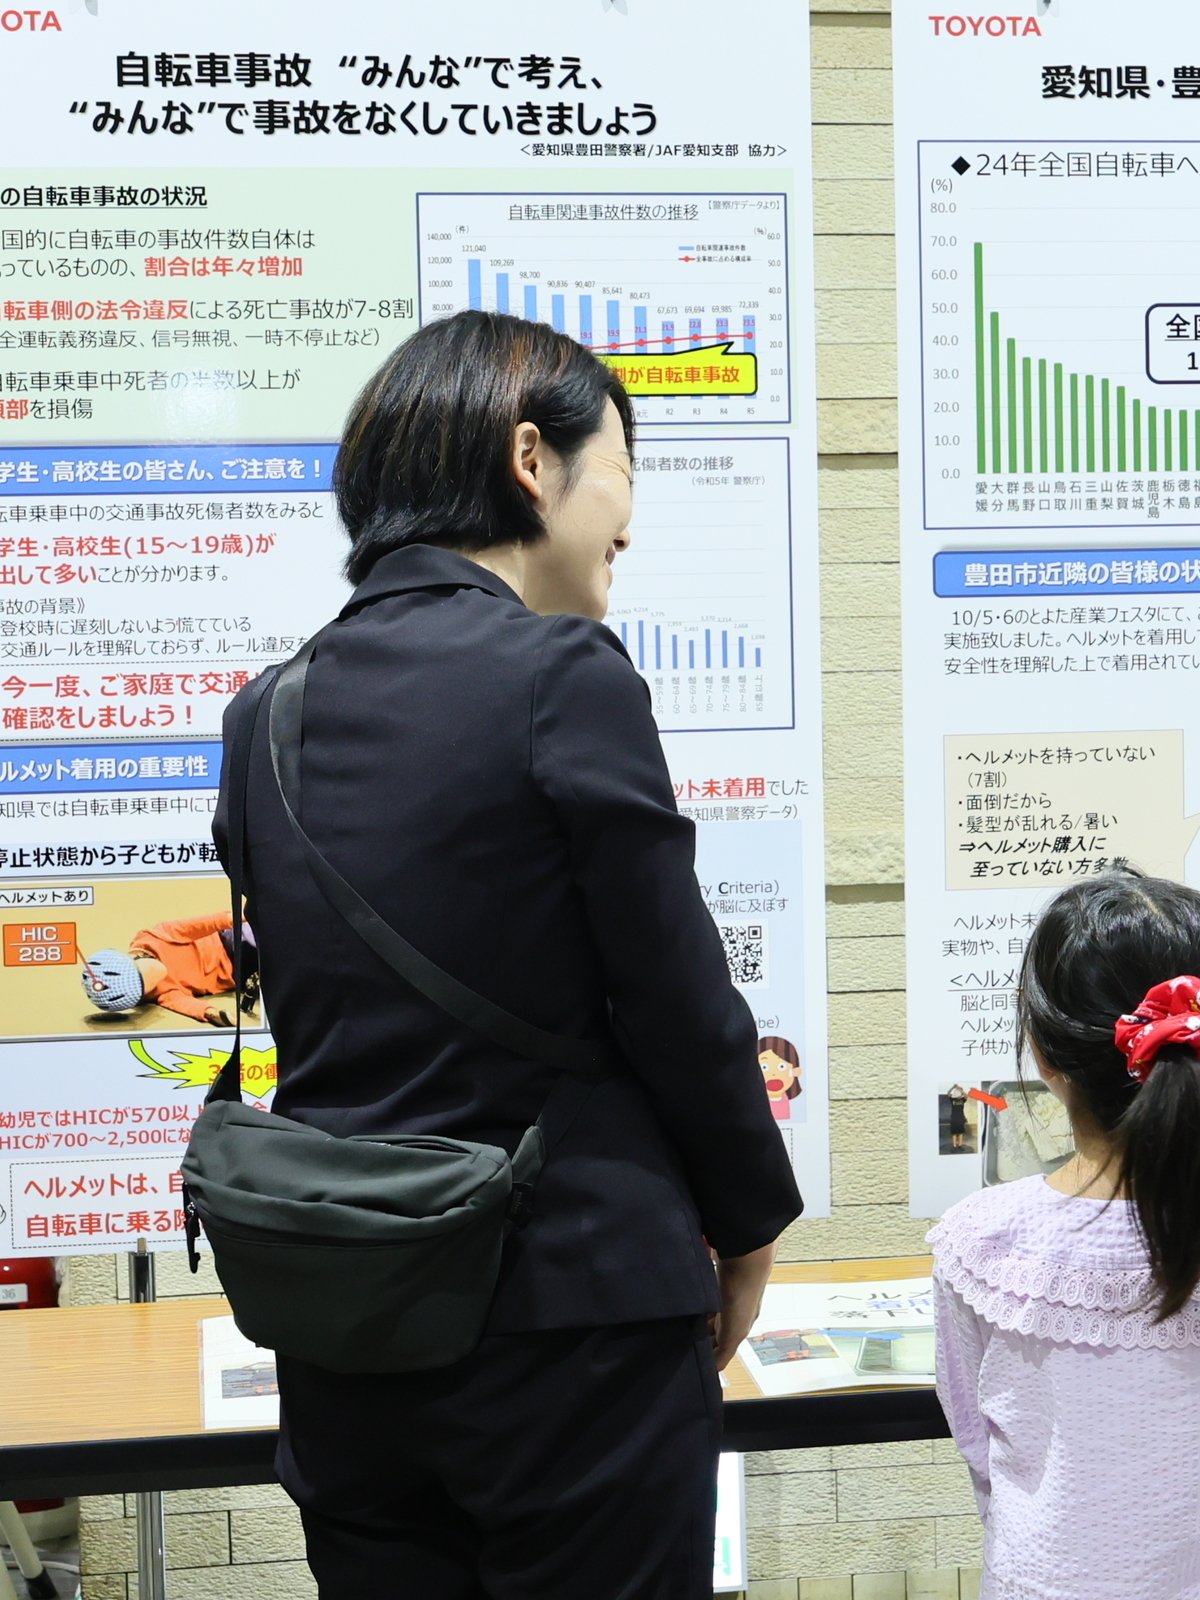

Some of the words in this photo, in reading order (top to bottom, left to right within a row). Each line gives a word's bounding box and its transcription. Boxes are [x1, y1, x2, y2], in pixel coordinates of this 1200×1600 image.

[1, 10, 62, 31] OTA
[928, 16, 1042, 36] TOYOTA
[115, 52, 312, 88] 自転車事故
[930, 178, 953, 193] (%)
[1, 186, 207, 207] の自転車事故の状況
[509, 203, 699, 220] 自転車関連事故件数の推移
[930, 202, 957, 213] 80.0
[2, 229, 315, 250] 国的に自転車の事故件数自体は
[931, 236, 957, 247] 70.0
[519, 272, 540, 280] 98,700
[931, 269, 958, 280] 60.0
[932, 302, 958, 313] 50.0
[932, 335, 959, 346] 40.0
[0, 369, 300, 393] 転車乗車中死者の半数以上が
[933, 368, 959, 380] 30.0
[0, 398, 93, 420] 部を損傷
[933, 402, 960, 413] 20.0
[934, 435, 960, 446] 10.0
[941, 468, 960, 479] 0.0
[991, 482, 1004, 512] 大分
[1038, 482, 1050, 511] 山口
[1069, 481, 1082, 511] 石川
[1085, 481, 1098, 511] 三重
[1147, 480, 1160, 519] 鹿児島
[1163, 480, 1175, 509] 栃木
[0, 597, 85, 615] 故の背景》
[1, 617, 251, 637] 登校時に遅刻しないよう慌てている
[0, 755, 209, 782] ルメット着用の重要性
[0, 890, 89, 904] ヘルメットあり
[718, 879, 780, 897] Criteria)
[954, 912, 1038, 930] ヘルメット未
[21, 927, 58, 943] HIC
[19, 946, 62, 963] 288
